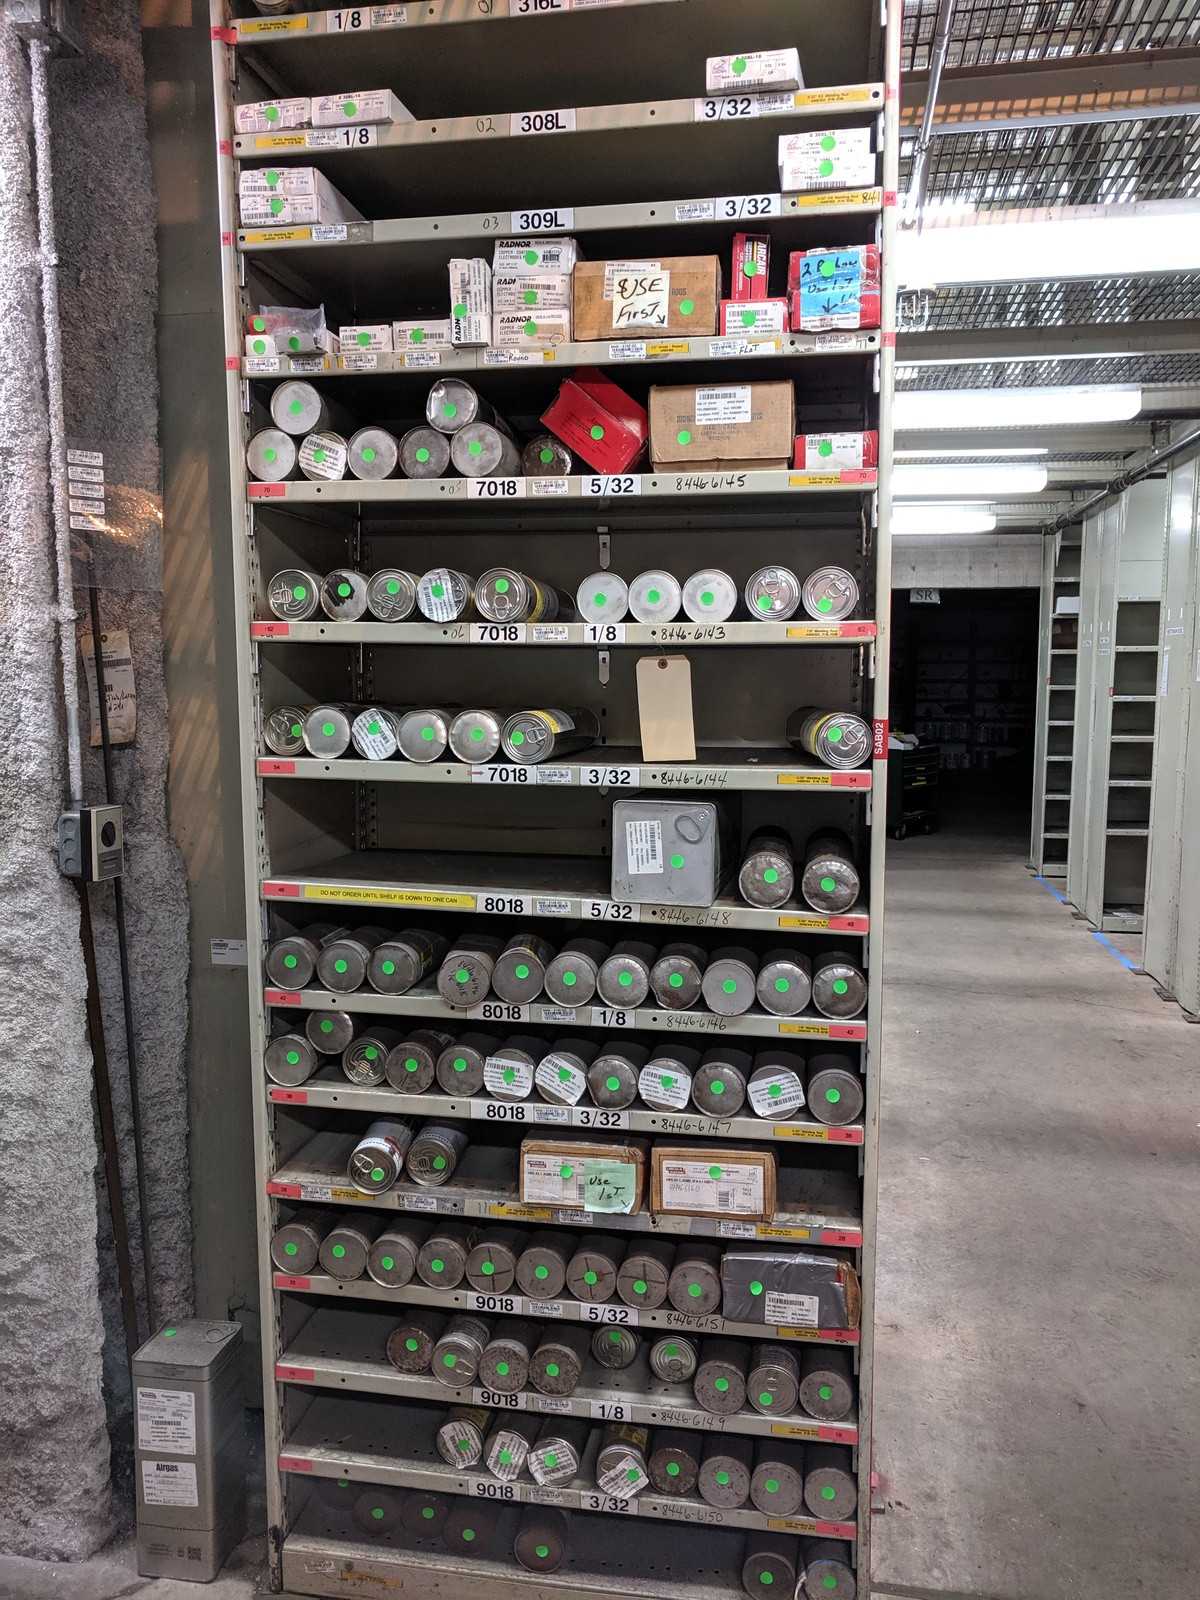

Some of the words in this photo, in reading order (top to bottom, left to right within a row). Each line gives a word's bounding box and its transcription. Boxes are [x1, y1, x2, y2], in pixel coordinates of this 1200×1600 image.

[335, 10, 362, 32] 1/8
[706, 98, 751, 120] 3/32
[521, 112, 566, 132] 308L
[343, 128, 370, 148] 1/8
[726, 198, 772, 219] 3/32
[519, 212, 564, 230] 309L
[499, 240, 532, 248] RADNOR
[500, 316, 532, 324] RADNOR
[476, 481, 517, 496] 7018
[590, 478, 634, 496] 5/32
[478, 625, 518, 641] 7018
[590, 625, 616, 643] 1/8
[874, 722, 884, 755] SAB02
[488, 768, 528, 783] 7018
[588, 768, 631, 786] 3/32
[484, 898, 524, 914] 8018
[590, 903, 632, 921] 5/32
[482, 1004, 522, 1020] 8018
[600, 1010, 626, 1026] 1/8
[486, 1104, 525, 1121] 8018
[580, 1110, 621, 1128] 3/32
[476, 1296, 514, 1312] 9018
[588, 1306, 629, 1324] 5/32
[480, 1390, 519, 1408] 9018
[598, 1403, 624, 1421] 1/8
[156, 1464, 179, 1472] Airgas
[476, 1483, 514, 1499] 9018
[590, 1496, 630, 1514] 3/32
